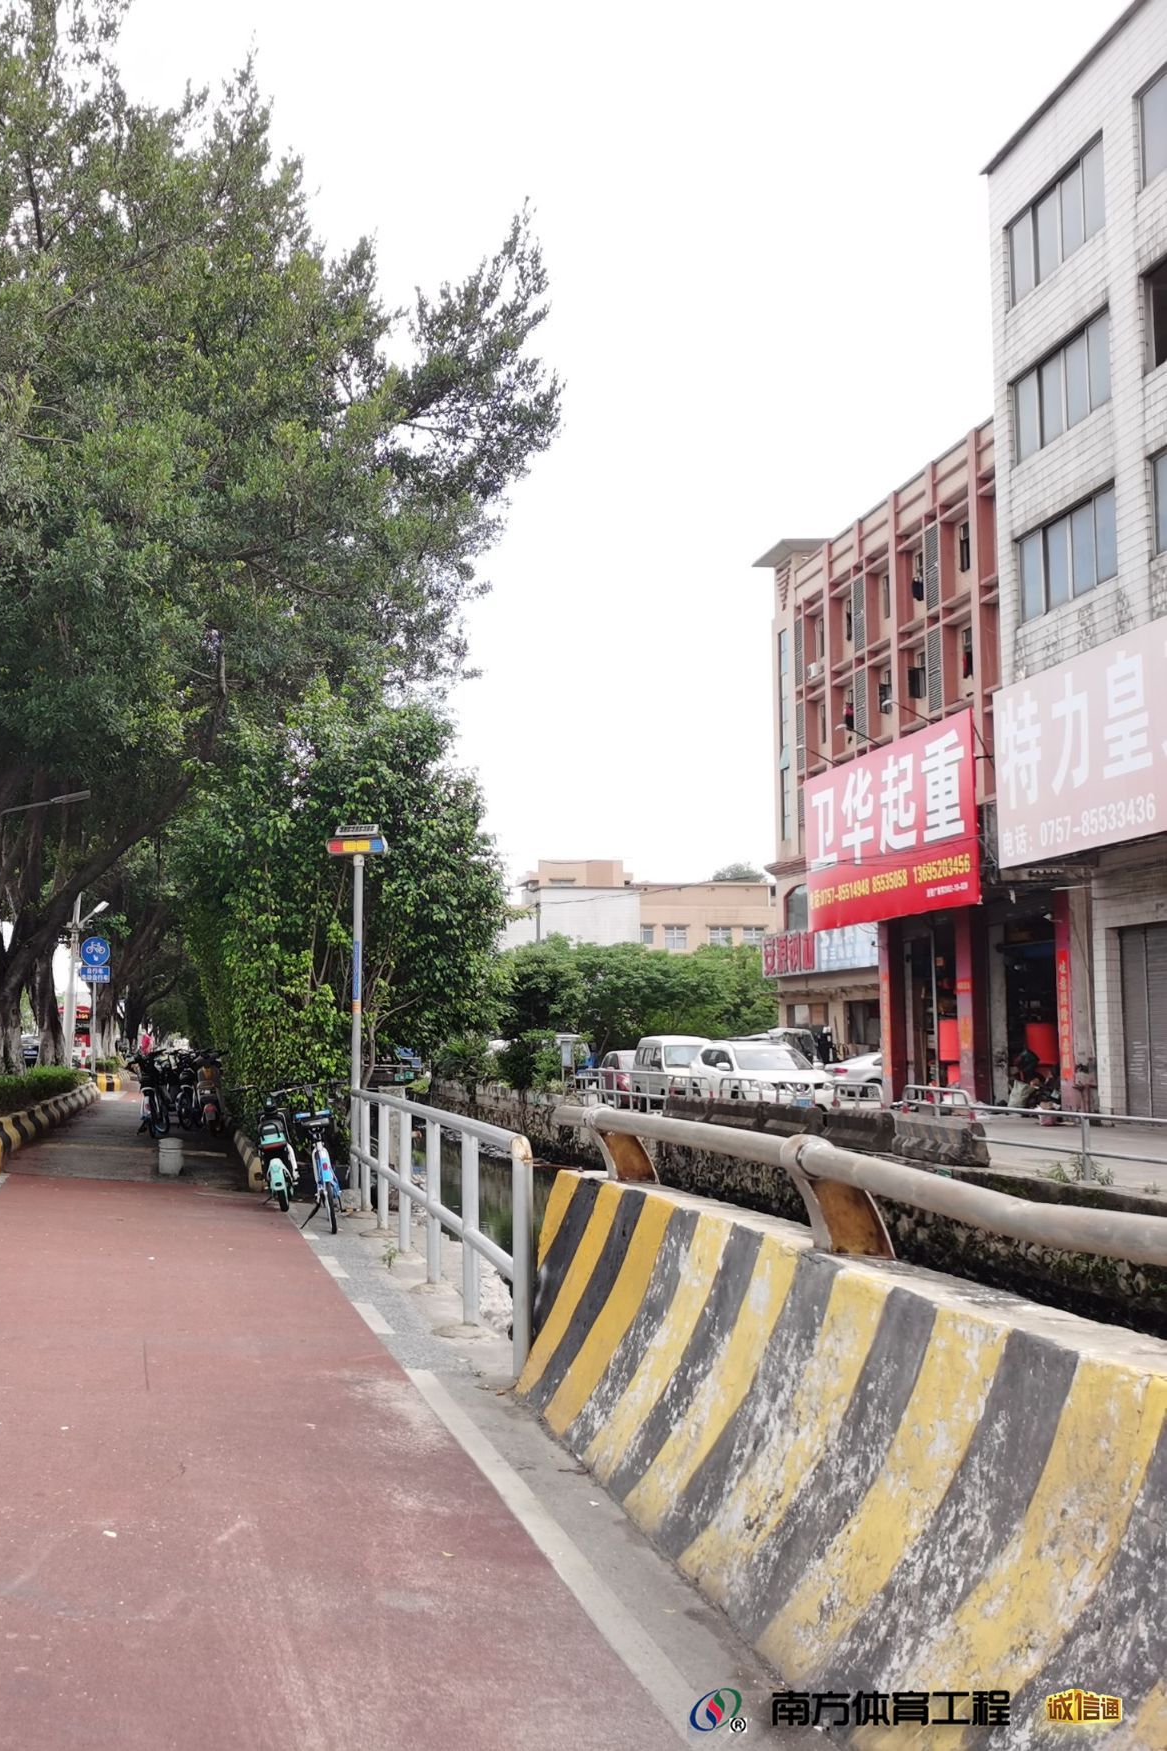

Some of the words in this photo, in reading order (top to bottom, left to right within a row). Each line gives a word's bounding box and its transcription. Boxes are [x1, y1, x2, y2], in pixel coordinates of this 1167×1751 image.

[811, 729, 965, 873] 卫华起重
[1000, 645, 1167, 810] 特力皇
